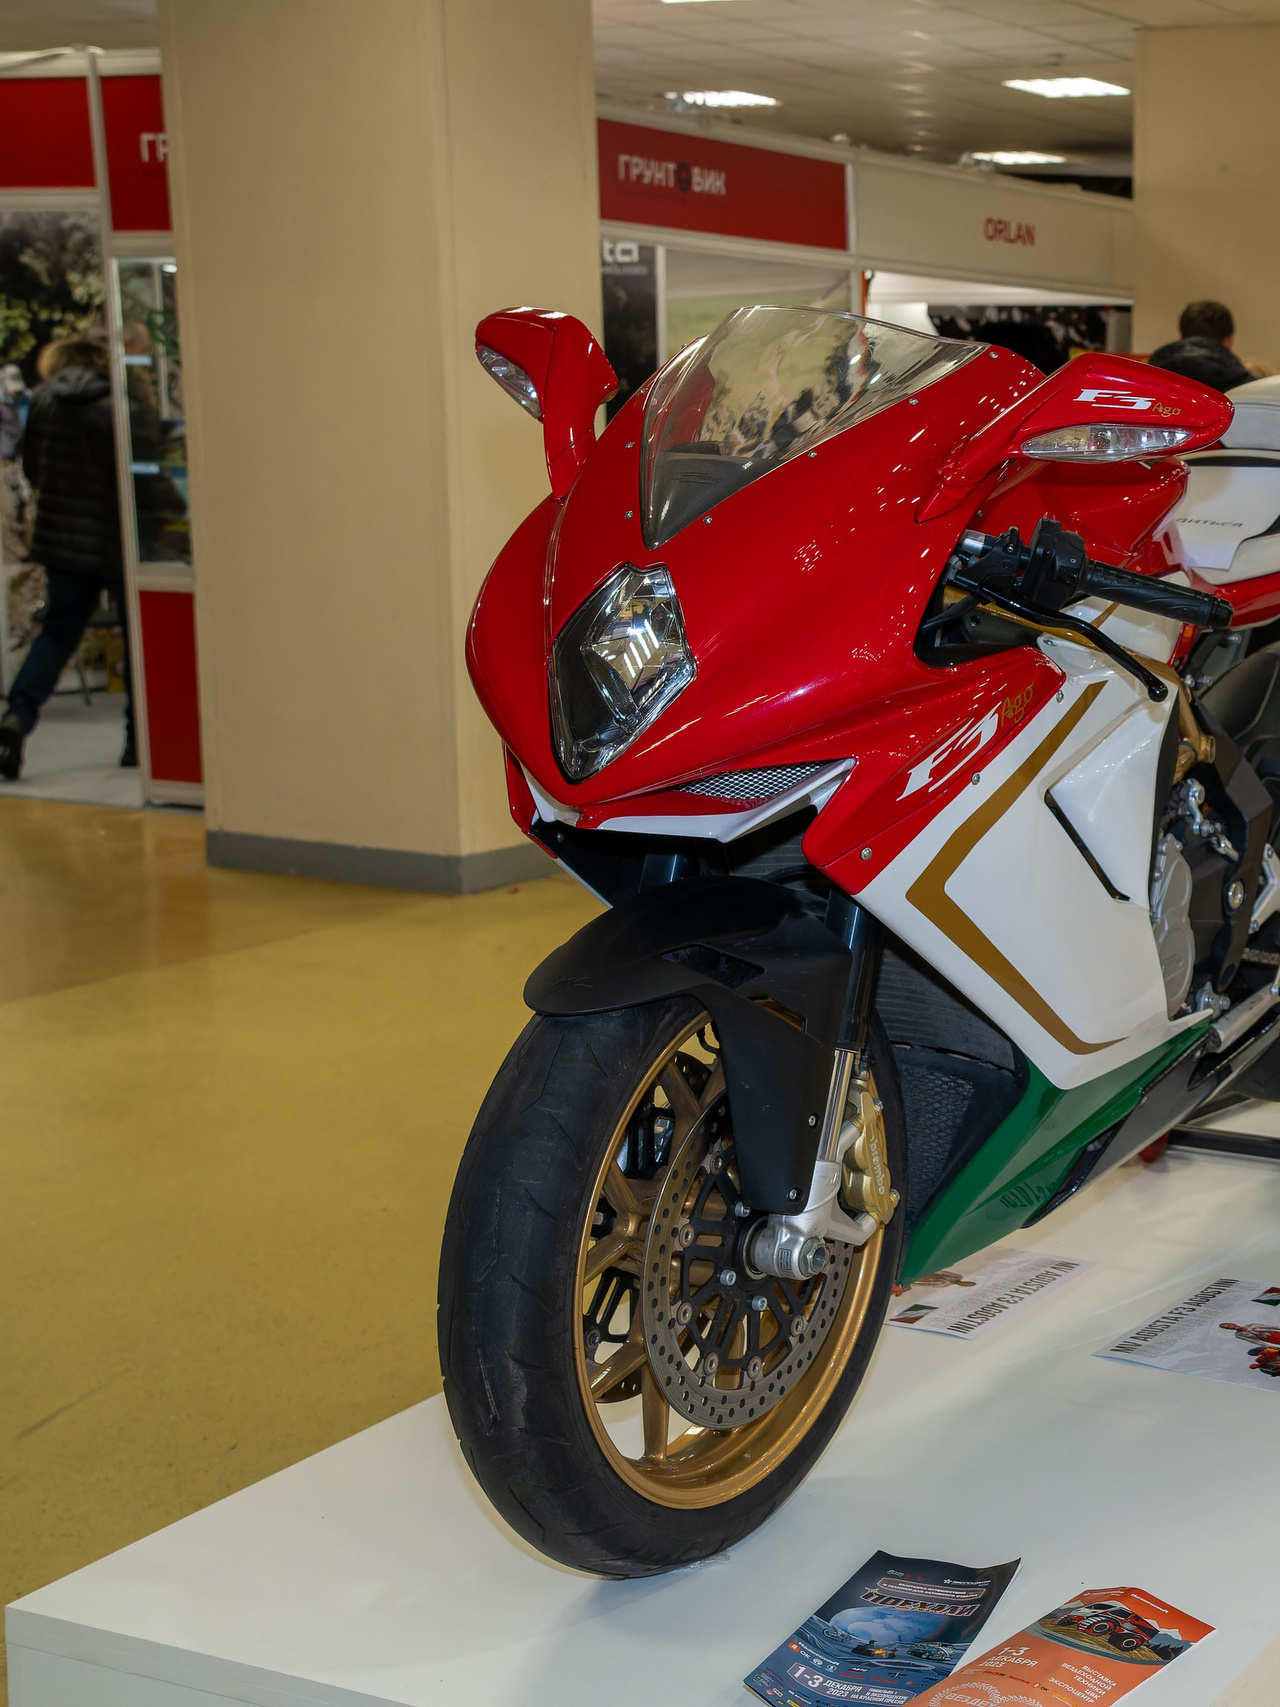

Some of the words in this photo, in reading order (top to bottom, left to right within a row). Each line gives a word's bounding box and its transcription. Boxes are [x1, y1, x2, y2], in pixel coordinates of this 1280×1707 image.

[984, 217, 1035, 246] ORLAN
[1073, 389, 1156, 410] F3
[1151, 402, 1181, 418] Ago
[896, 701, 1002, 801] F3
[1001, 682, 1034, 727] Ago
[1055, 1260, 1080, 1274] MV
[1011, 1270, 1063, 1295] AGUSTA
[999, 1291, 1024, 1306] F3
[946, 1298, 1009, 1334] AGOSTINI
[1110, 1340, 1142, 1354] MV
[1135, 1314, 1184, 1342] AGUSTA
[1168, 1306, 1197, 1317] F3
[1183, 1278, 1240, 1308] AGOSTINI
[986, 1656, 1038, 1668] ДЕКАБРЯ
[999, 1647, 1030, 1656] 1-3
[978, 1660, 1006, 1668] 2023
[793, 1666, 824, 1688] 1-3
[823, 1680, 863, 1692] ДЕКАБРЯ
[1061, 1663, 1112, 1691] ВЕЗДЕХОДНОЙ
[1074, 1675, 1106, 1695] ТЕХНИКИ
[1082, 1665, 1116, 1687] ВЫСТАВКА
[827, 1688, 850, 1697] 2023
[1049, 1677, 1094, 1703] ЭКСПОЦЕНТР
